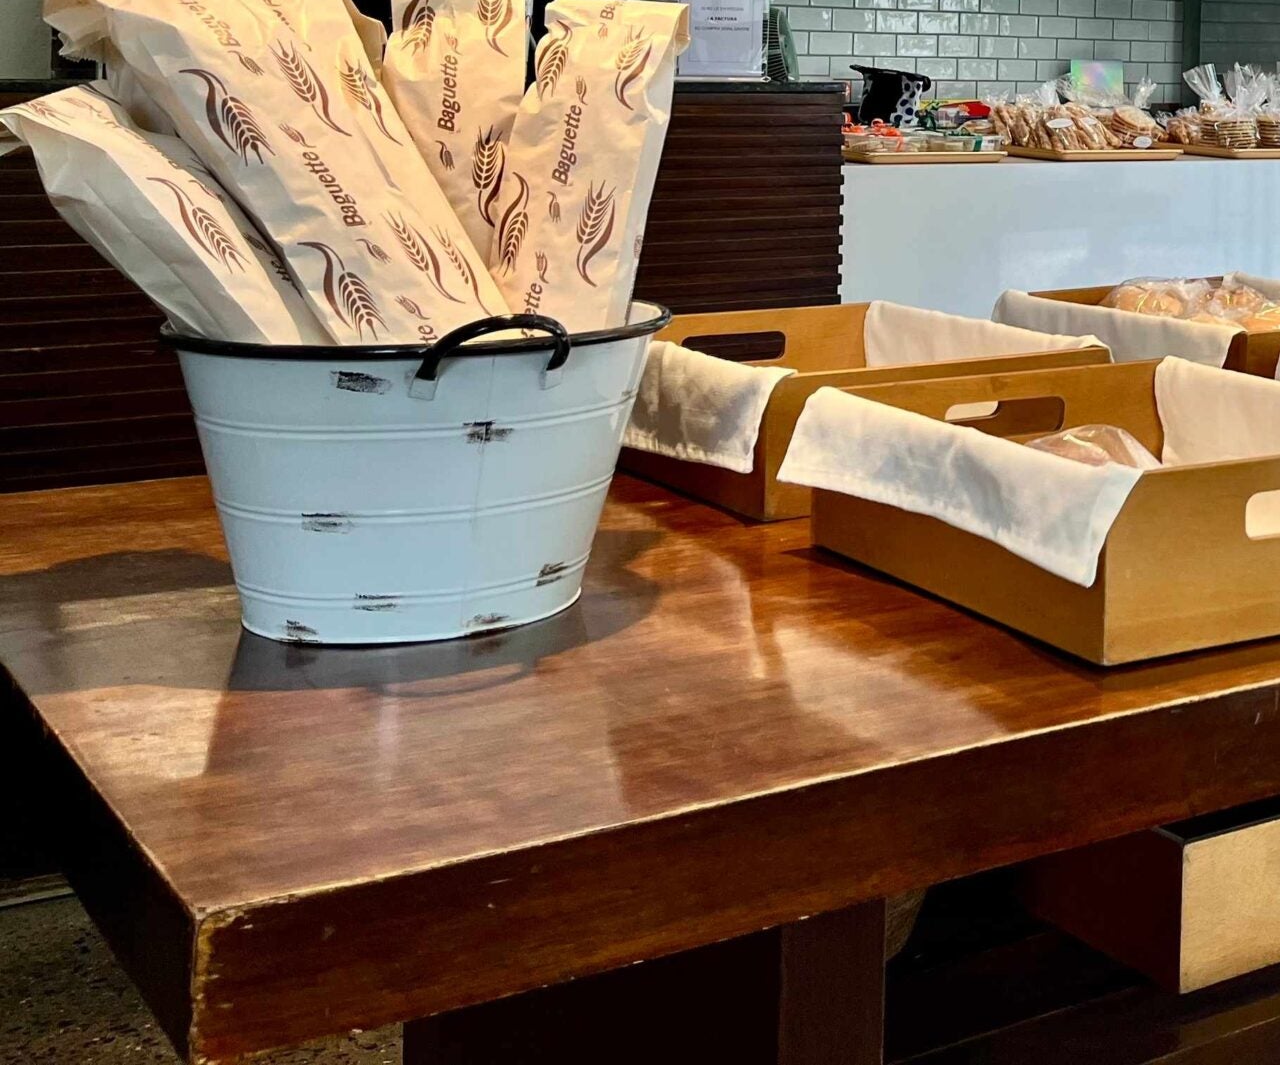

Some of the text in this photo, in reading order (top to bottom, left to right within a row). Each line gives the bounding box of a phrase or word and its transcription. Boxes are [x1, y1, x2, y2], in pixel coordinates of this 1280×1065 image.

[437, 53, 461, 132] Baguette
[551, 103, 583, 185] Baguette
[302, 150, 367, 227] Baguette
